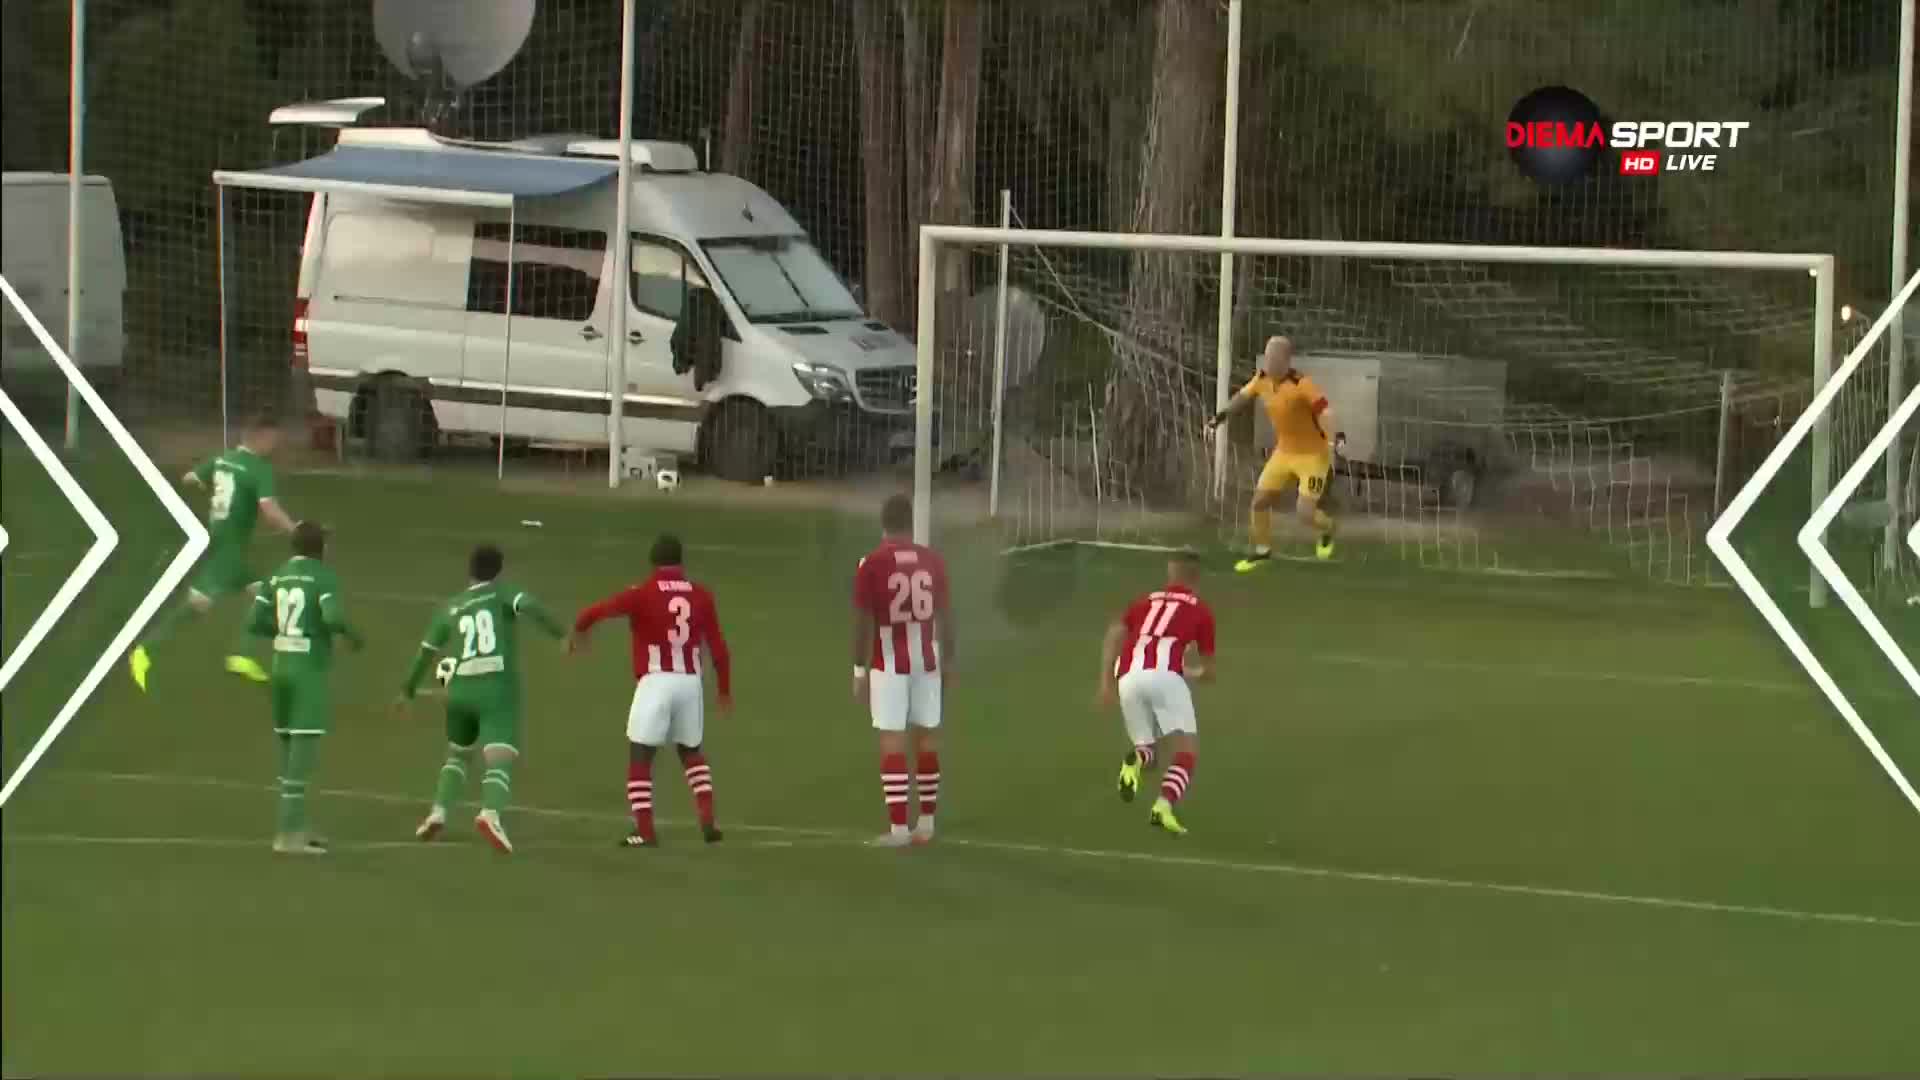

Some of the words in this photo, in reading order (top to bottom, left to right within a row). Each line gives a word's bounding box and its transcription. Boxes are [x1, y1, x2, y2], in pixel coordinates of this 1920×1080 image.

[667, 596, 691, 644] 3
[887, 570, 933, 624] 26
[1140, 599, 1180, 637] 11
[458, 609, 497, 661] 28
